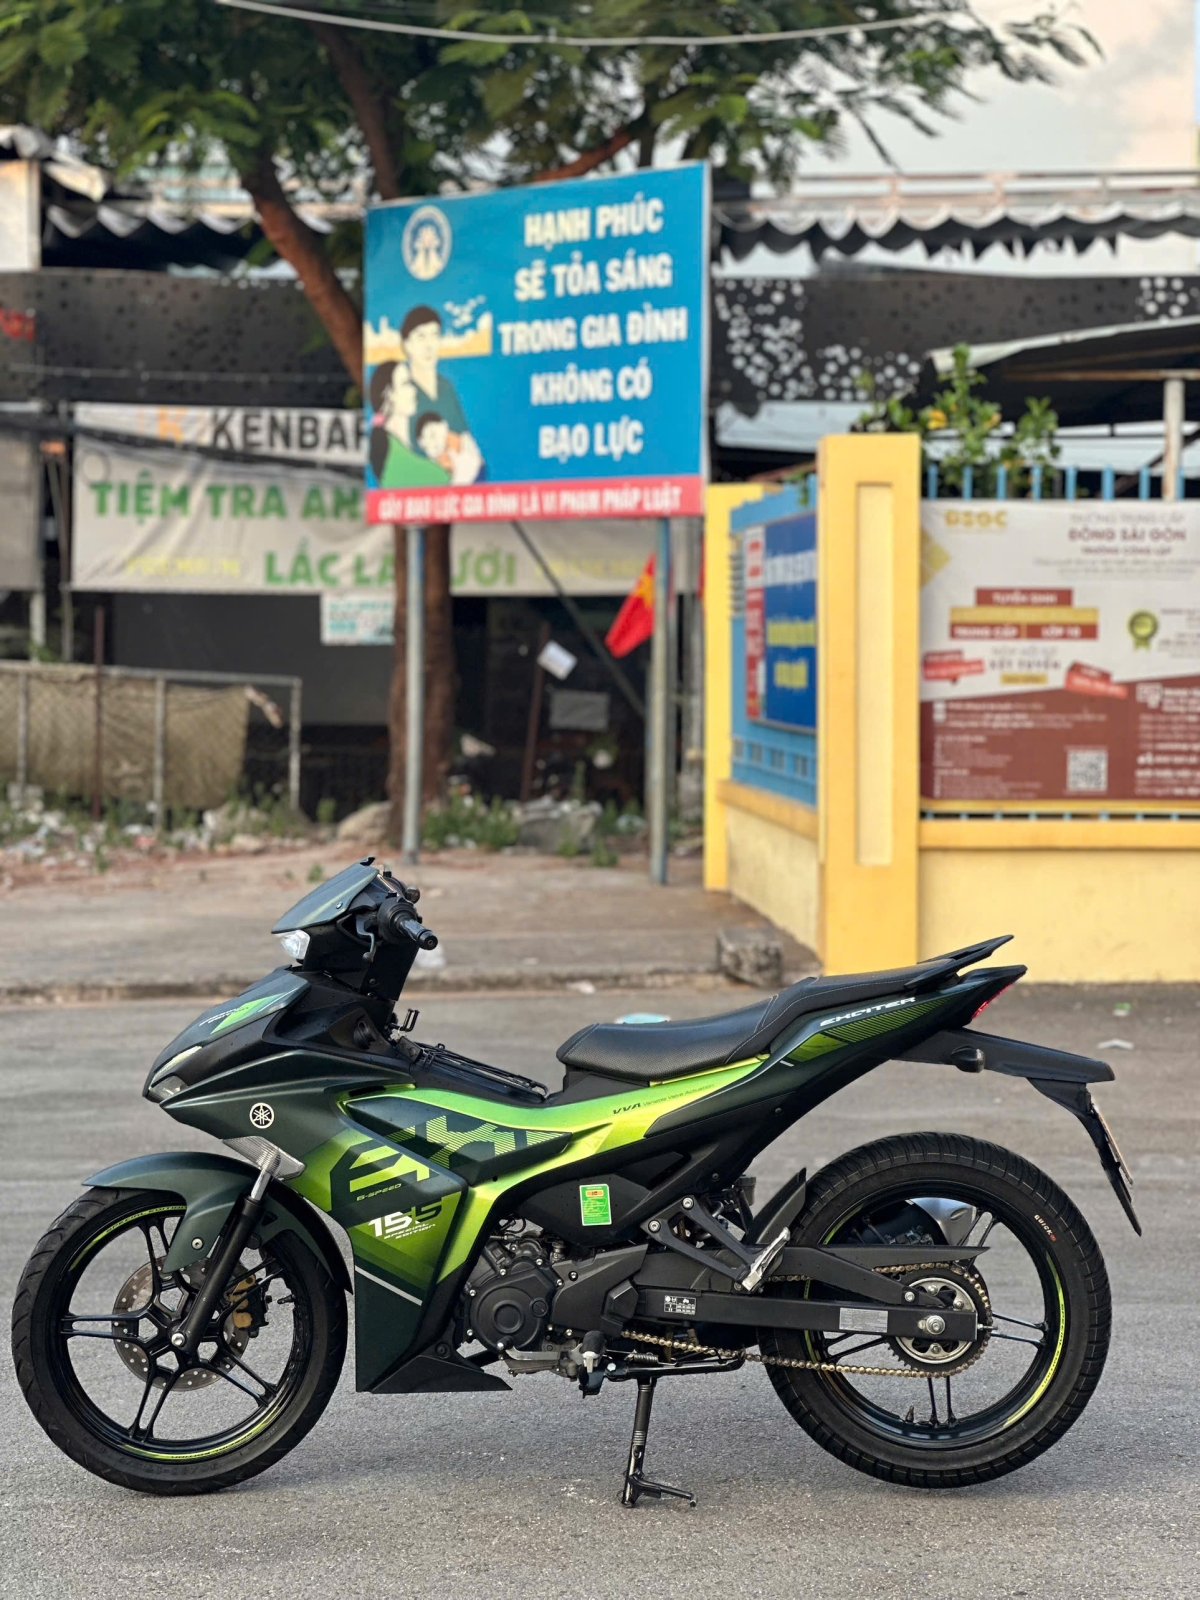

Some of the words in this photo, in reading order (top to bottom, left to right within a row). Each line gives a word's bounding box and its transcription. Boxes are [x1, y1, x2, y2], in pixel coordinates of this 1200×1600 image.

[524, 207, 591, 251] HẠNH
[595, 191, 664, 239] PHÚC
[514, 259, 546, 301] SẼ
[551, 250, 601, 297] TỎA
[605, 248, 673, 293] SÁNG
[498, 316, 577, 356] TRONG
[580, 312, 622, 349] GIA
[626, 301, 688, 345] ĐÌNH
[530, 362, 613, 406] KHÔNG
[616, 356, 653, 400] CÓ
[539, 423, 590, 464] BẠO
[593, 415, 644, 462] LỰC
[91, 471, 190, 523] TIỆM
[603, 482, 642, 510] PHÁP
[642, 480, 682, 514] LUẬT
[820, 996, 916, 1027] EXCITER
[612, 1102, 642, 1115] VVA
